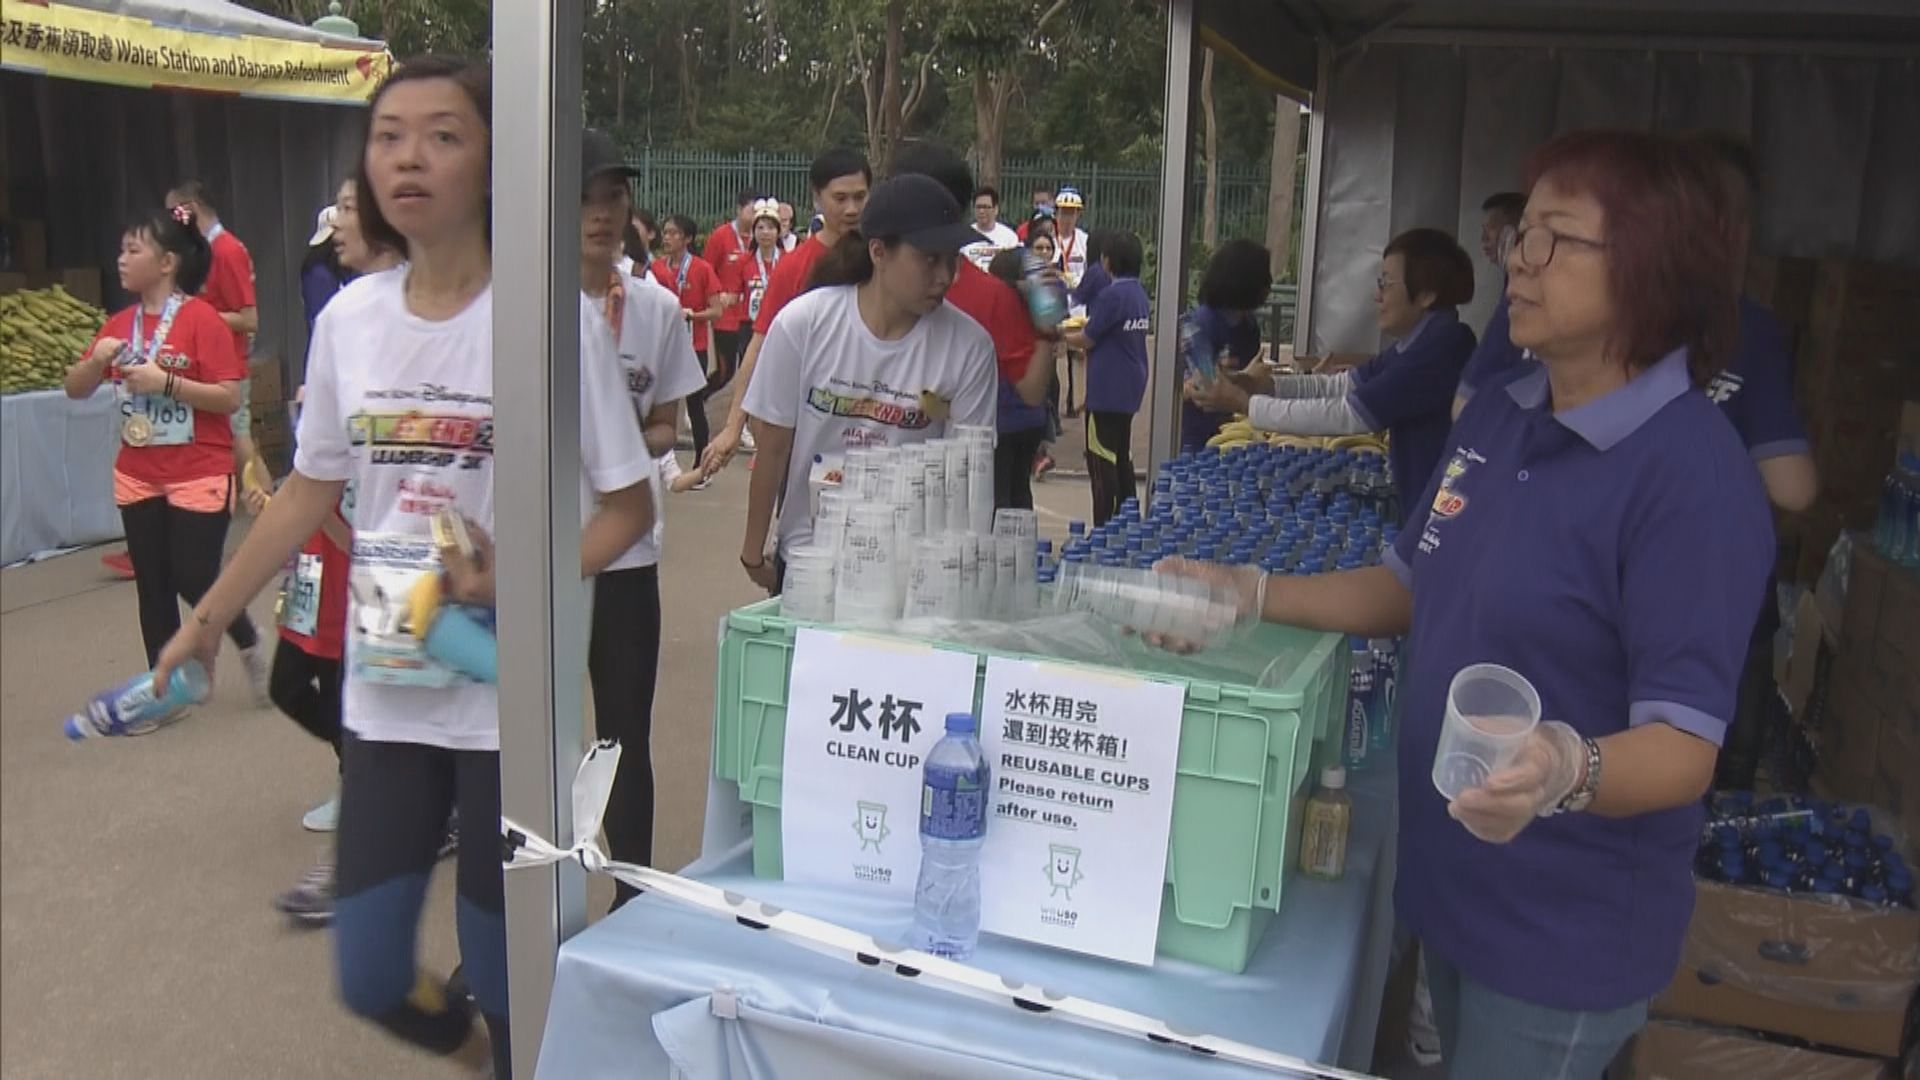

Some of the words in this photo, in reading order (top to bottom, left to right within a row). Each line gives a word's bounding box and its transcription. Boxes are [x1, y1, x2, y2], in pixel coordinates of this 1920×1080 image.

[117, 38, 158, 67] Water
[161, 46, 210, 74] Station
[212, 53, 236, 77] and
[238, 55, 284, 80] Banana
[829, 687, 924, 744] 水杯
[1004, 688, 1098, 724] 水杯用完
[826, 740, 880, 764] CLEAN
[884, 751, 920, 770] CUP
[1001, 753, 1095, 781] REUSABLE
[1101, 770, 1150, 792] CUPS
[999, 777, 1056, 800] Please
[1061, 789, 1114, 810] return
[996, 801, 1038, 820] after
[1042, 811, 1078, 828] use.
